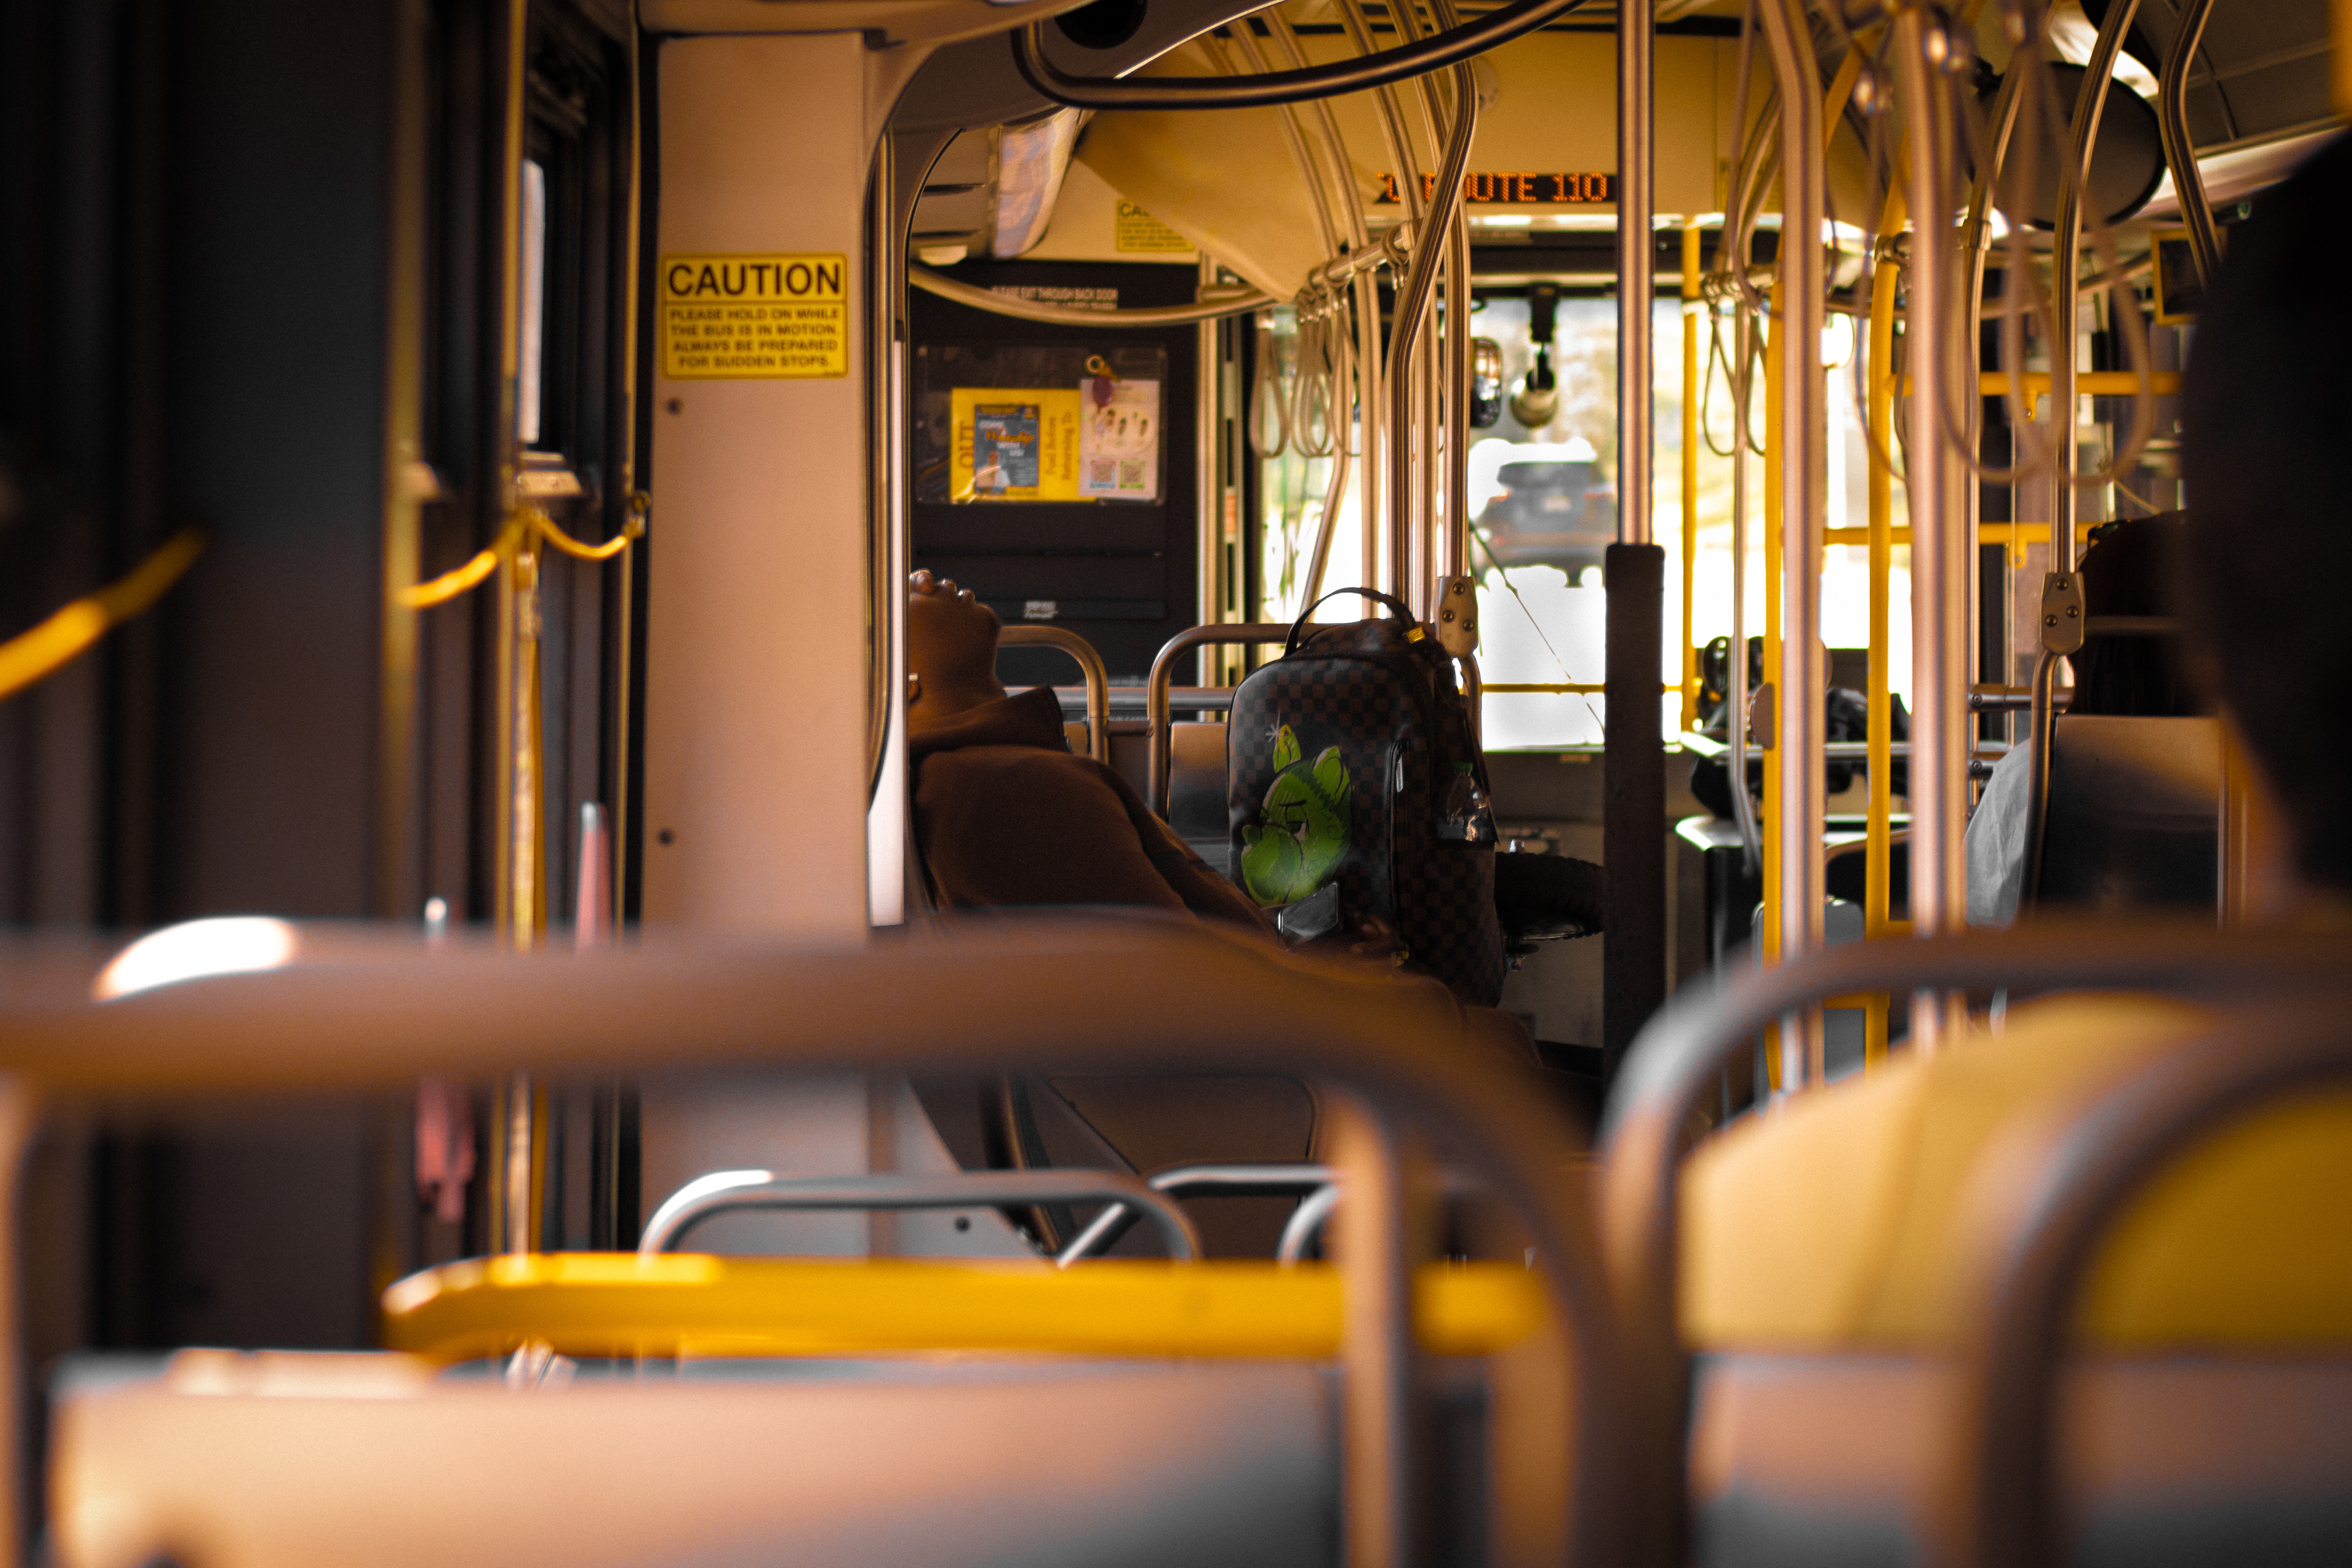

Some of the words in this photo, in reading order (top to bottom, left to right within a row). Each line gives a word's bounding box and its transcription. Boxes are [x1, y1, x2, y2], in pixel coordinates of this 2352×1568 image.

[1551, 172, 1607, 202] 110
[669, 264, 839, 295] CAUTION
[671, 308, 722, 320] PLEASE
[729, 308, 767, 320] HOLD
[771, 308, 793, 319] ON
[797, 307, 839, 318] WHILE
[671, 325, 698, 336] THE
[705, 325, 734, 336] BUS
[740, 324, 753, 335] IS
[758, 324, 772, 335] IN
[675, 340, 730, 352] ALWAYS
[737, 340, 753, 351] BE
[760, 339, 838, 351] PREPARED
[680, 356, 708, 367] FOR
[714, 356, 776, 366] SUDDEN
